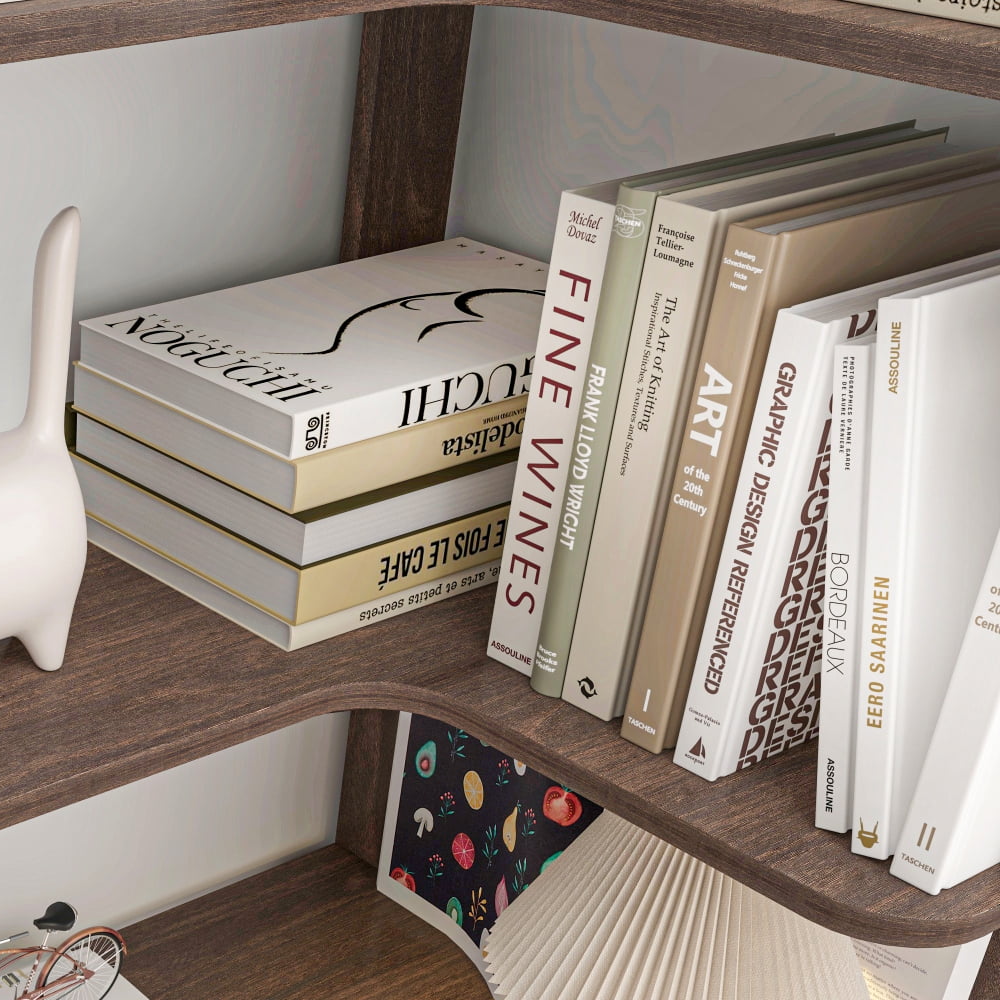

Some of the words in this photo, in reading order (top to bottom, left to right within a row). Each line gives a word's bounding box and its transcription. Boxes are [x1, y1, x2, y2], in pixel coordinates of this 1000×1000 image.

[566, 225, 597, 244] Dovaz
[568, 210, 603, 231] Michel
[657, 224, 695, 242] Françoise
[653, 248, 695, 268] Loumagne
[656, 236, 685, 252] Tellier-
[644, 292, 662, 348] Inspirational
[662, 297, 678, 324] The
[538, 269, 592, 409] FINE
[656, 328, 671, 353] Art
[104, 315, 322, 403] NOGUCHI
[653, 355, 665, 373] of
[888, 322, 901, 394] ASSOULINE
[582, 364, 607, 423] FRANK
[631, 387, 644, 421] Textures
[637, 374, 663, 432] Knitting
[689, 363, 733, 458] ART
[628, 423, 636, 441] and
[758, 362, 797, 468] GRAPHIC
[573, 426, 596, 480] LLOYD
[620, 441, 633, 477] Surfaces
[683, 481, 703, 497] 20th
[684, 465, 695, 476] of
[696, 467, 710, 482] the
[559, 484, 585, 551] WRIGHT
[673, 493, 708, 517] Century
[736, 472, 770, 555] DESIGN
[454, 523, 492, 560] FOIS
[505, 438, 564, 615] WINES
[378, 546, 424, 591] CAFÉ
[427, 537, 450, 569] LE
[409, 583, 443, 604] petits
[445, 579, 458, 591] et
[461, 574, 485, 587] arts
[359, 598, 404, 622] secrets
[703, 558, 750, 695] REFERENCED
[826, 552, 849, 675] BORDEAUX
[869, 576, 890, 674] SAARINEN
[490, 640, 532, 666] ASSOULINE
[867, 681, 885, 728] EERO
[627, 716, 656, 735] TASCHEN
[825, 758, 834, 813] ASSOULINE
[900, 852, 936, 875] TASCHEN
